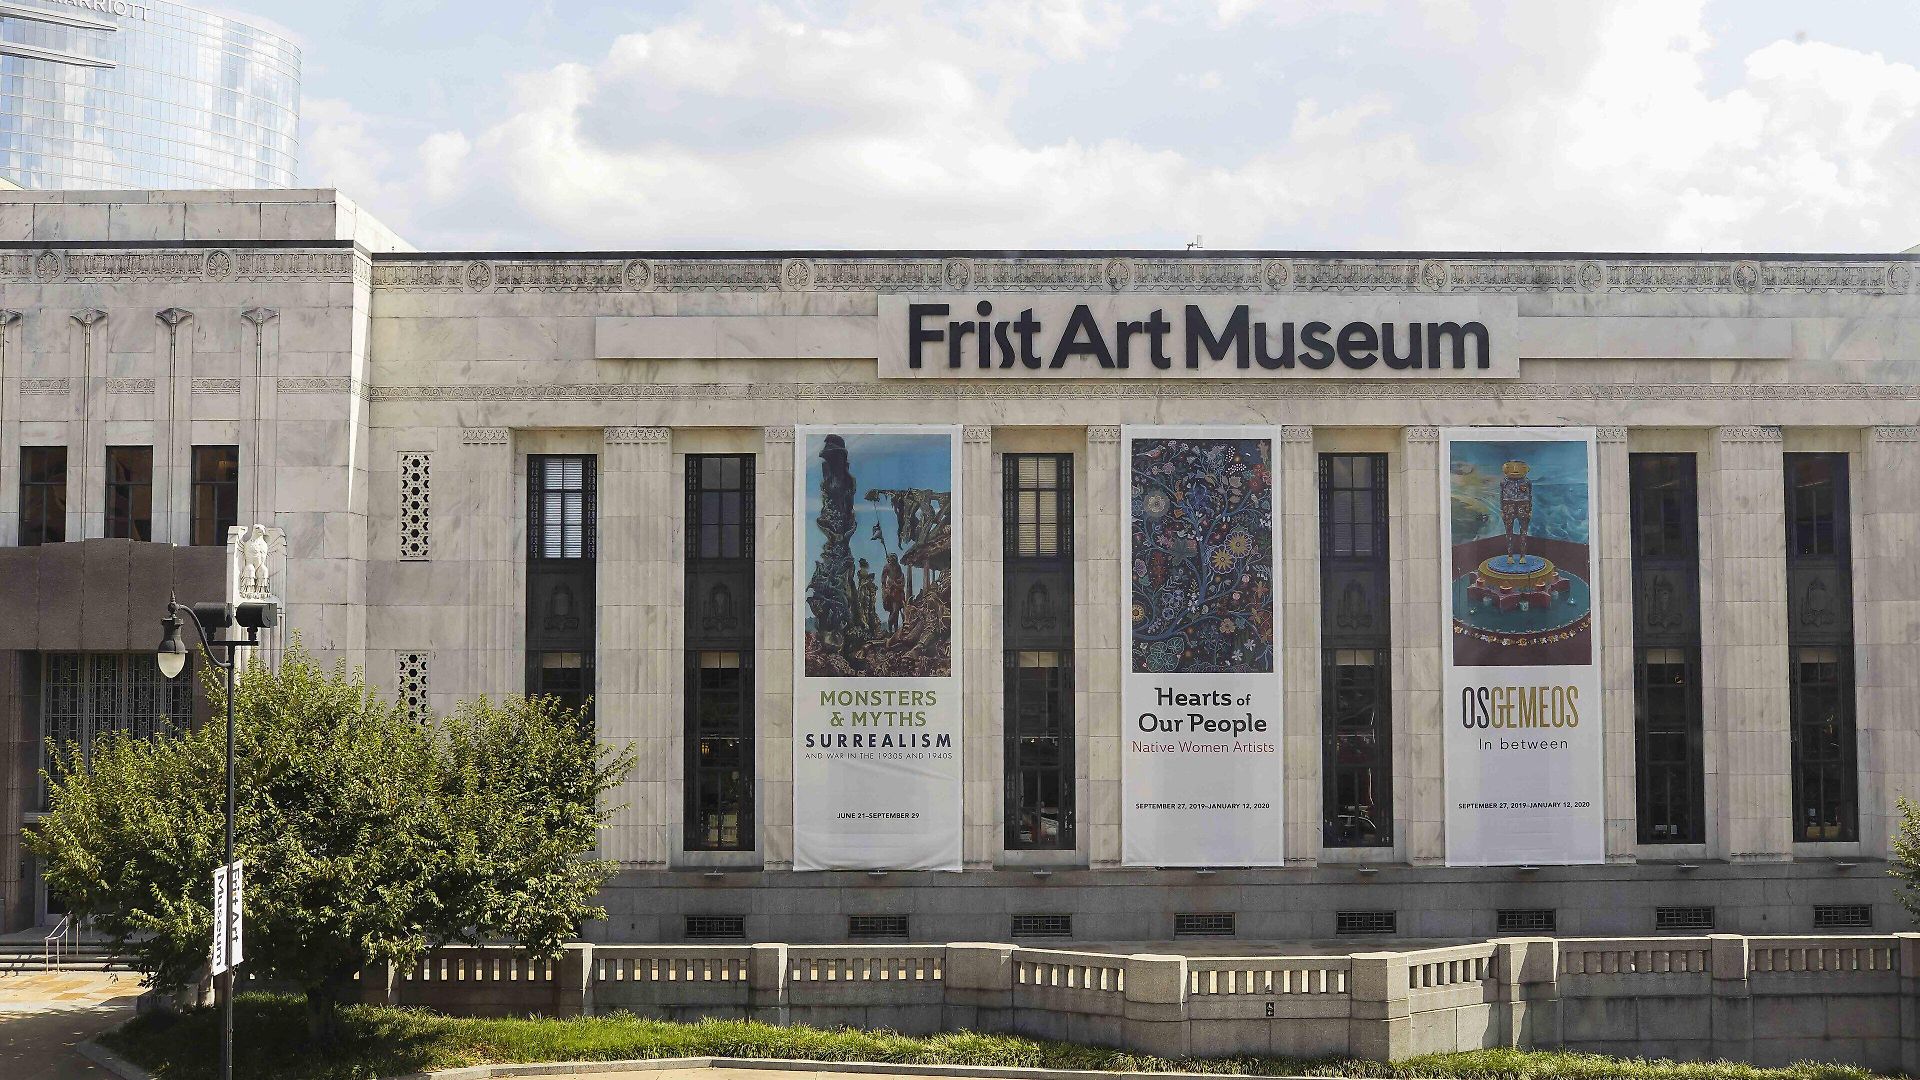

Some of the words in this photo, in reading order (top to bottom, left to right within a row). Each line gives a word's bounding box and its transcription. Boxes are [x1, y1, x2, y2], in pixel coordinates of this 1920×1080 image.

[51, 0, 150, 21] RRIOTT
[908, 300, 1041, 370] Frist
[1048, 304, 1171, 370] Art
[1184, 303, 1490, 370] Museum
[820, 690, 937, 707] MONSTERS
[1154, 687, 1232, 707] Hearts
[1237, 694, 1252, 706] of
[1462, 685, 1579, 729] OSGEMEOS
[829, 711, 845, 727] &
[851, 711, 927, 727] MYTHS
[1138, 713, 1184, 732] Our
[1187, 713, 1267, 738] People
[805, 733, 952, 748] SURREALISM
[1132, 741, 1175, 753] Native
[1178, 741, 1229, 753] Women
[1233, 741, 1275, 753] Artists
[1479, 738, 1492, 750] In
[1500, 738, 1569, 750] between
[805, 752, 823, 760] AND
[826, 752, 844, 760] WAR
[847, 752, 857, 760] IN
[860, 752, 874, 760] THE
[878, 752, 903, 760] 1930S
[906, 752, 924, 760] AND
[927, 752, 953, 760] 1940S
[1499, 802, 1509, 810] 27,
[836, 812, 856, 820] JUNE
[911, 812, 920, 820] 29
